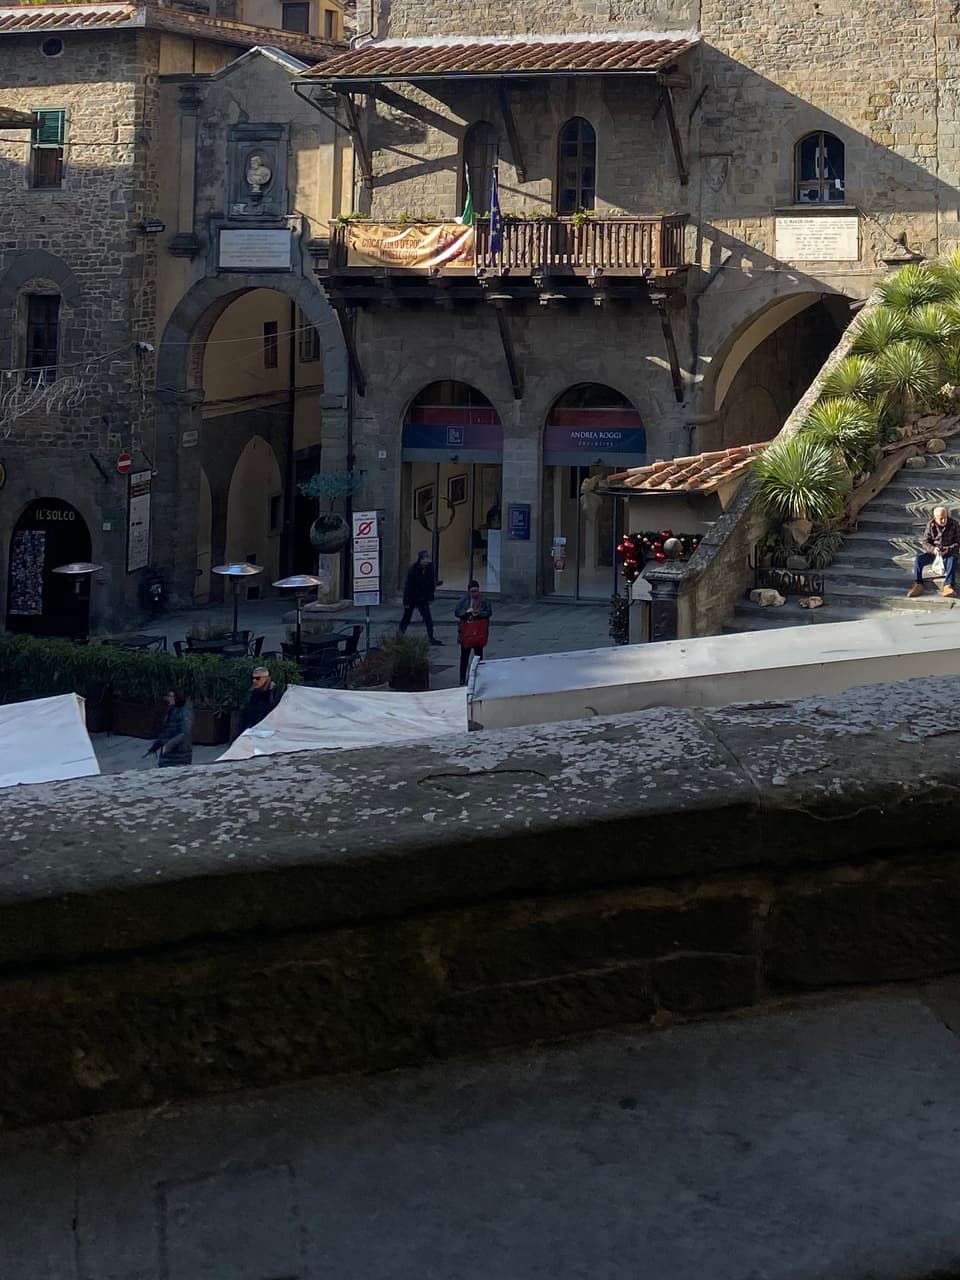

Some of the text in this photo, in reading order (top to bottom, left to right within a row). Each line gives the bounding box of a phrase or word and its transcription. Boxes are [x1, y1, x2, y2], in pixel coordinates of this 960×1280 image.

[570, 431, 622, 439] ANDREA ROGGI
[36, 509, 75, 521] IL SOLCO
